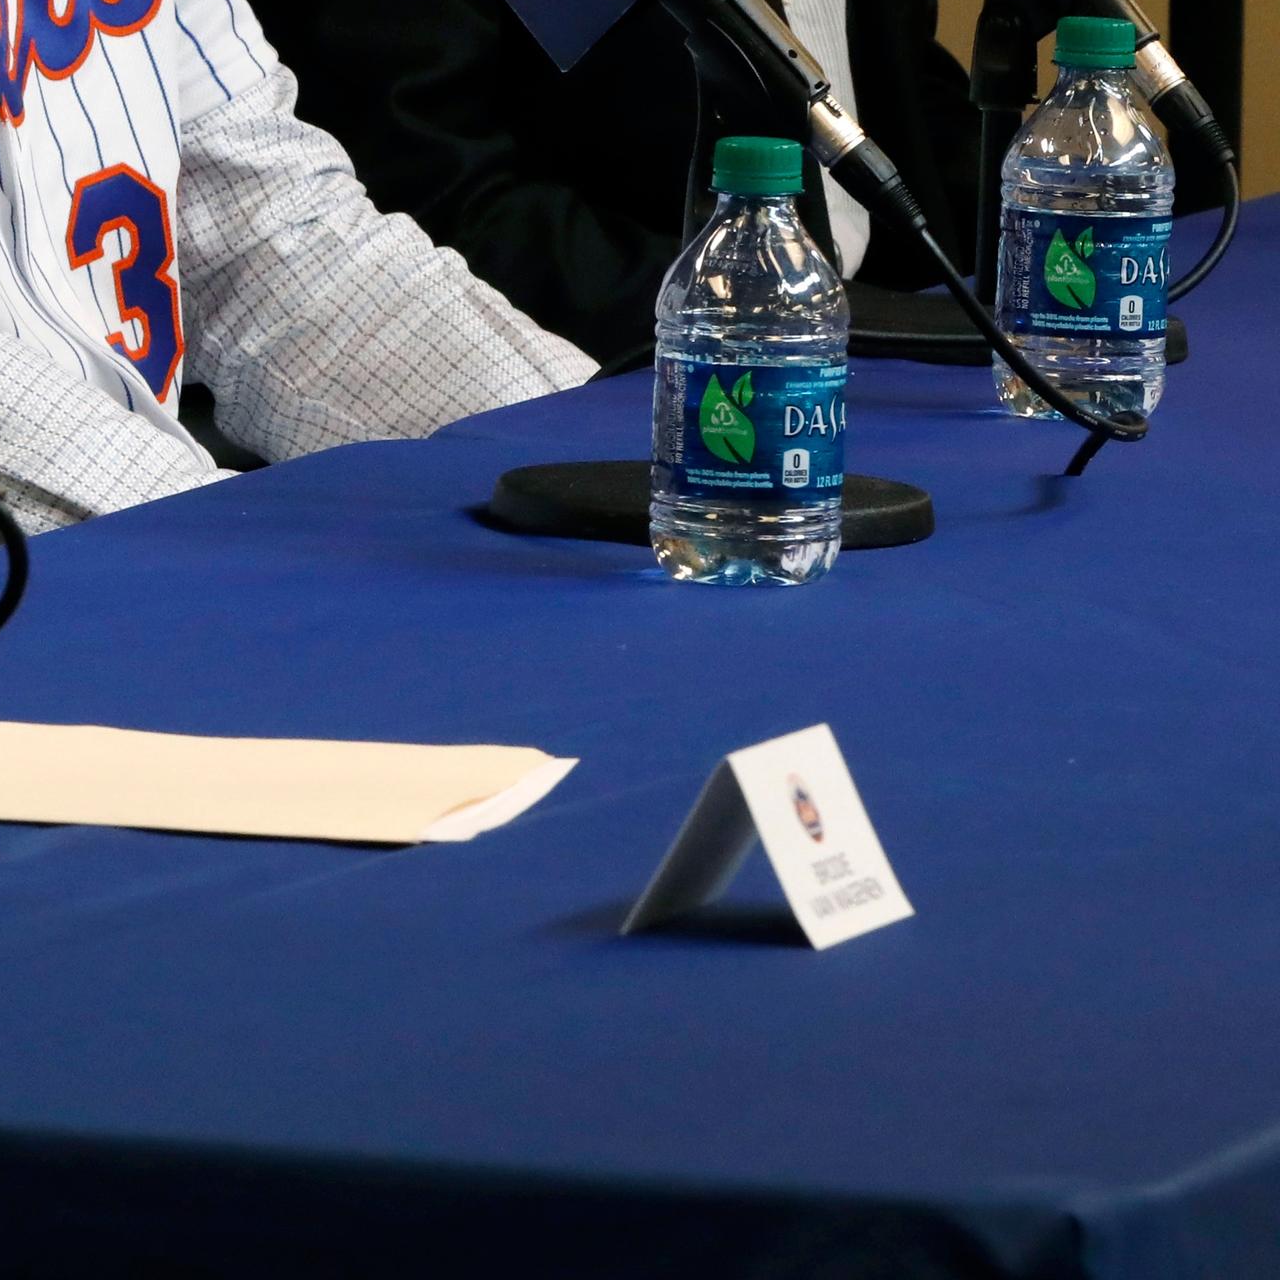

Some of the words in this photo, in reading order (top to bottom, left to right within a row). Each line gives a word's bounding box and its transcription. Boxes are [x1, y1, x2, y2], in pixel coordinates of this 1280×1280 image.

[1128, 300, 1135, 313] 0
[784, 394, 847, 442] DASA
[793, 453, 800, 468] 0
